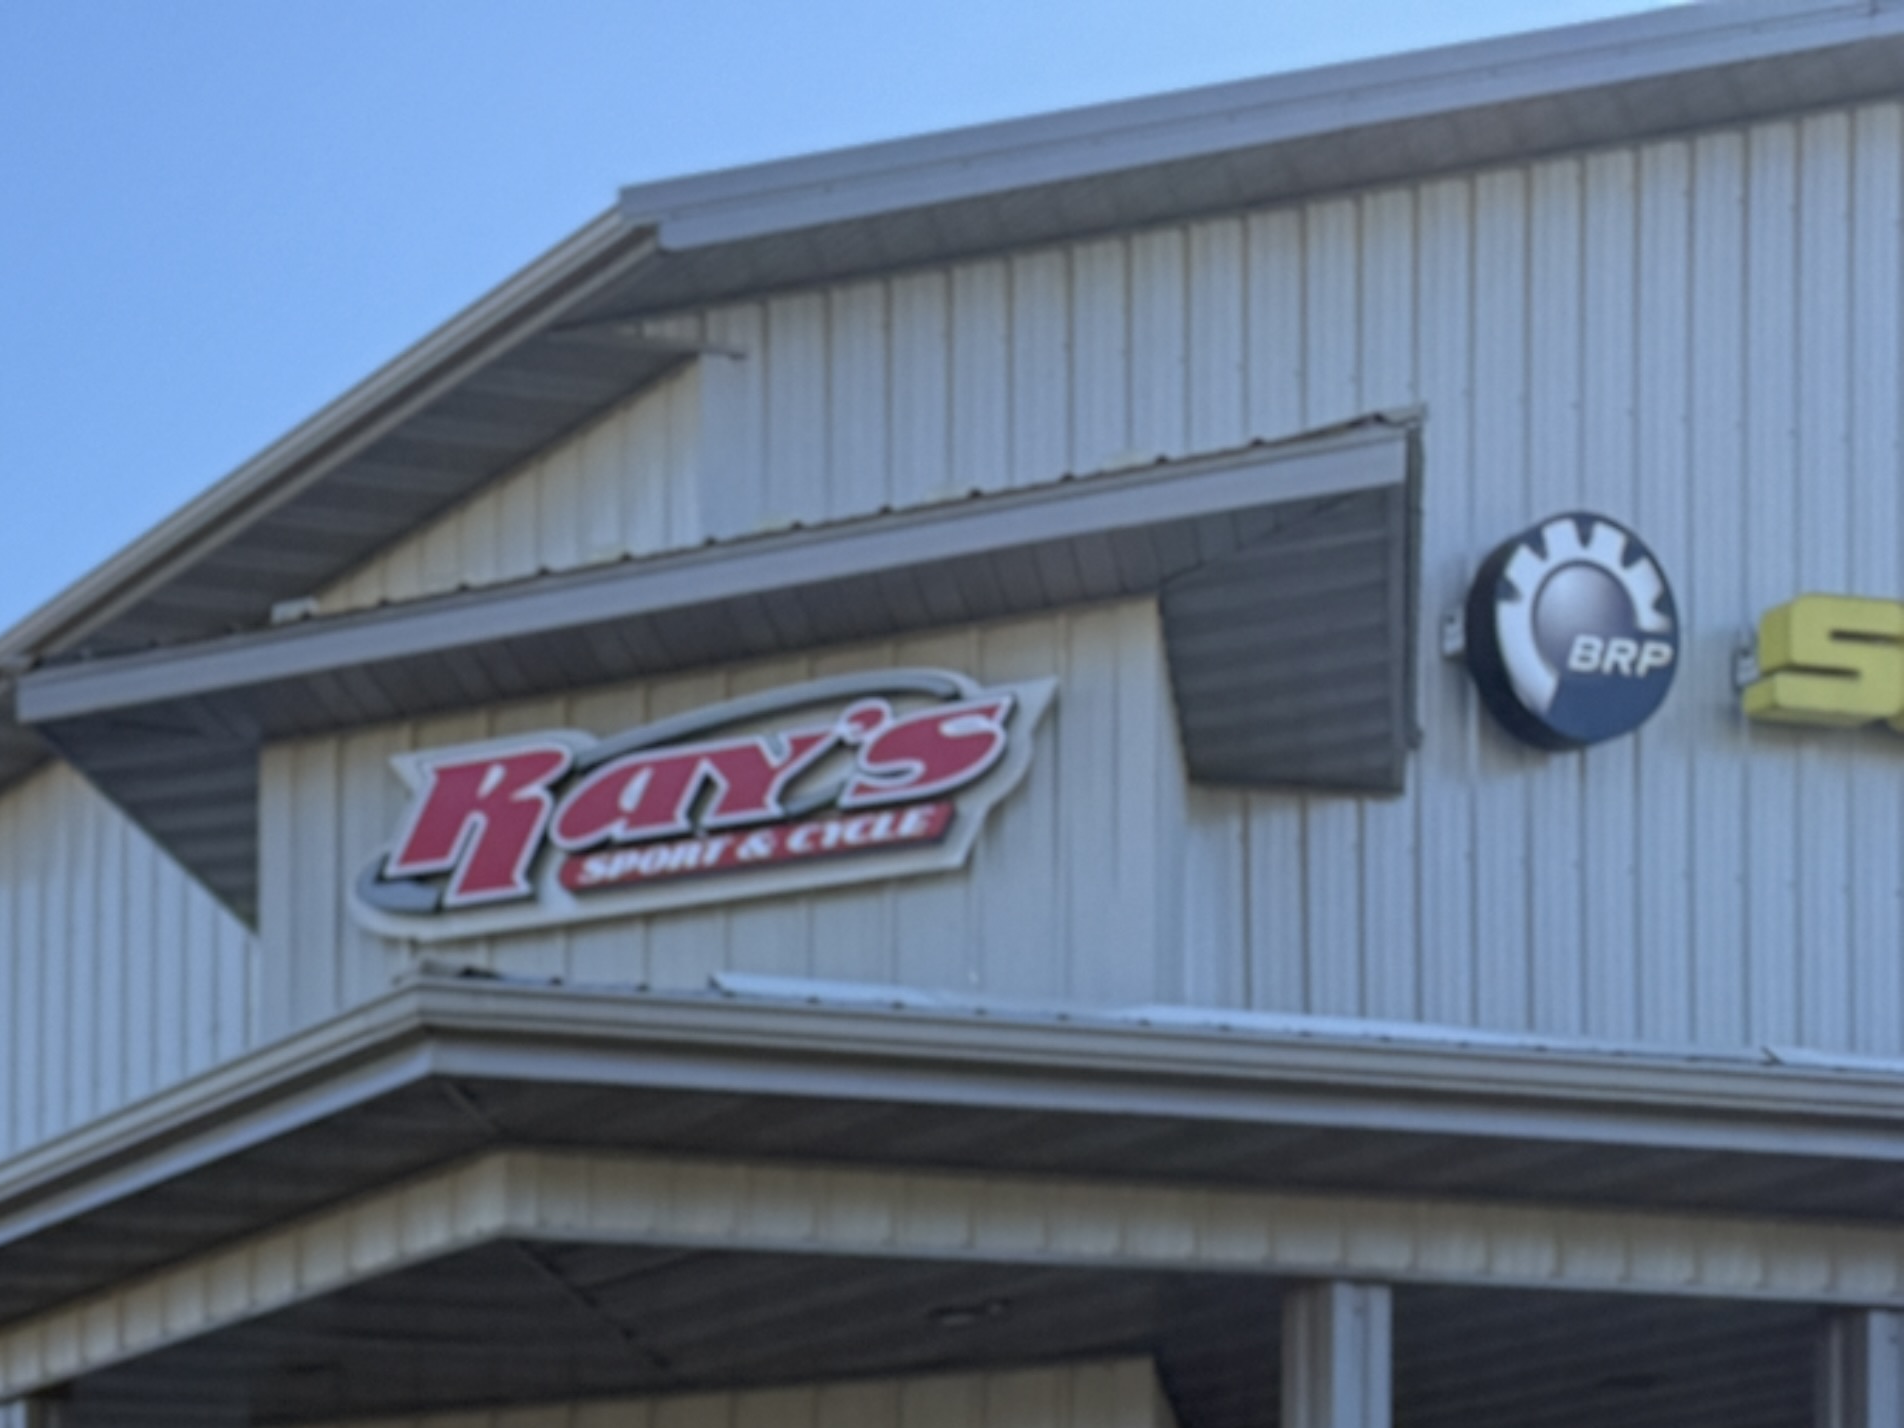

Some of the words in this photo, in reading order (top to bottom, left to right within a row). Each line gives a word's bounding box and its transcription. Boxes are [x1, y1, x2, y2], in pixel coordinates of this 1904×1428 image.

[1566, 632, 1674, 679] BRP
[576, 838, 732, 885] SPORT
[739, 831, 774, 860] &
[788, 806, 934, 852] CYCLE
